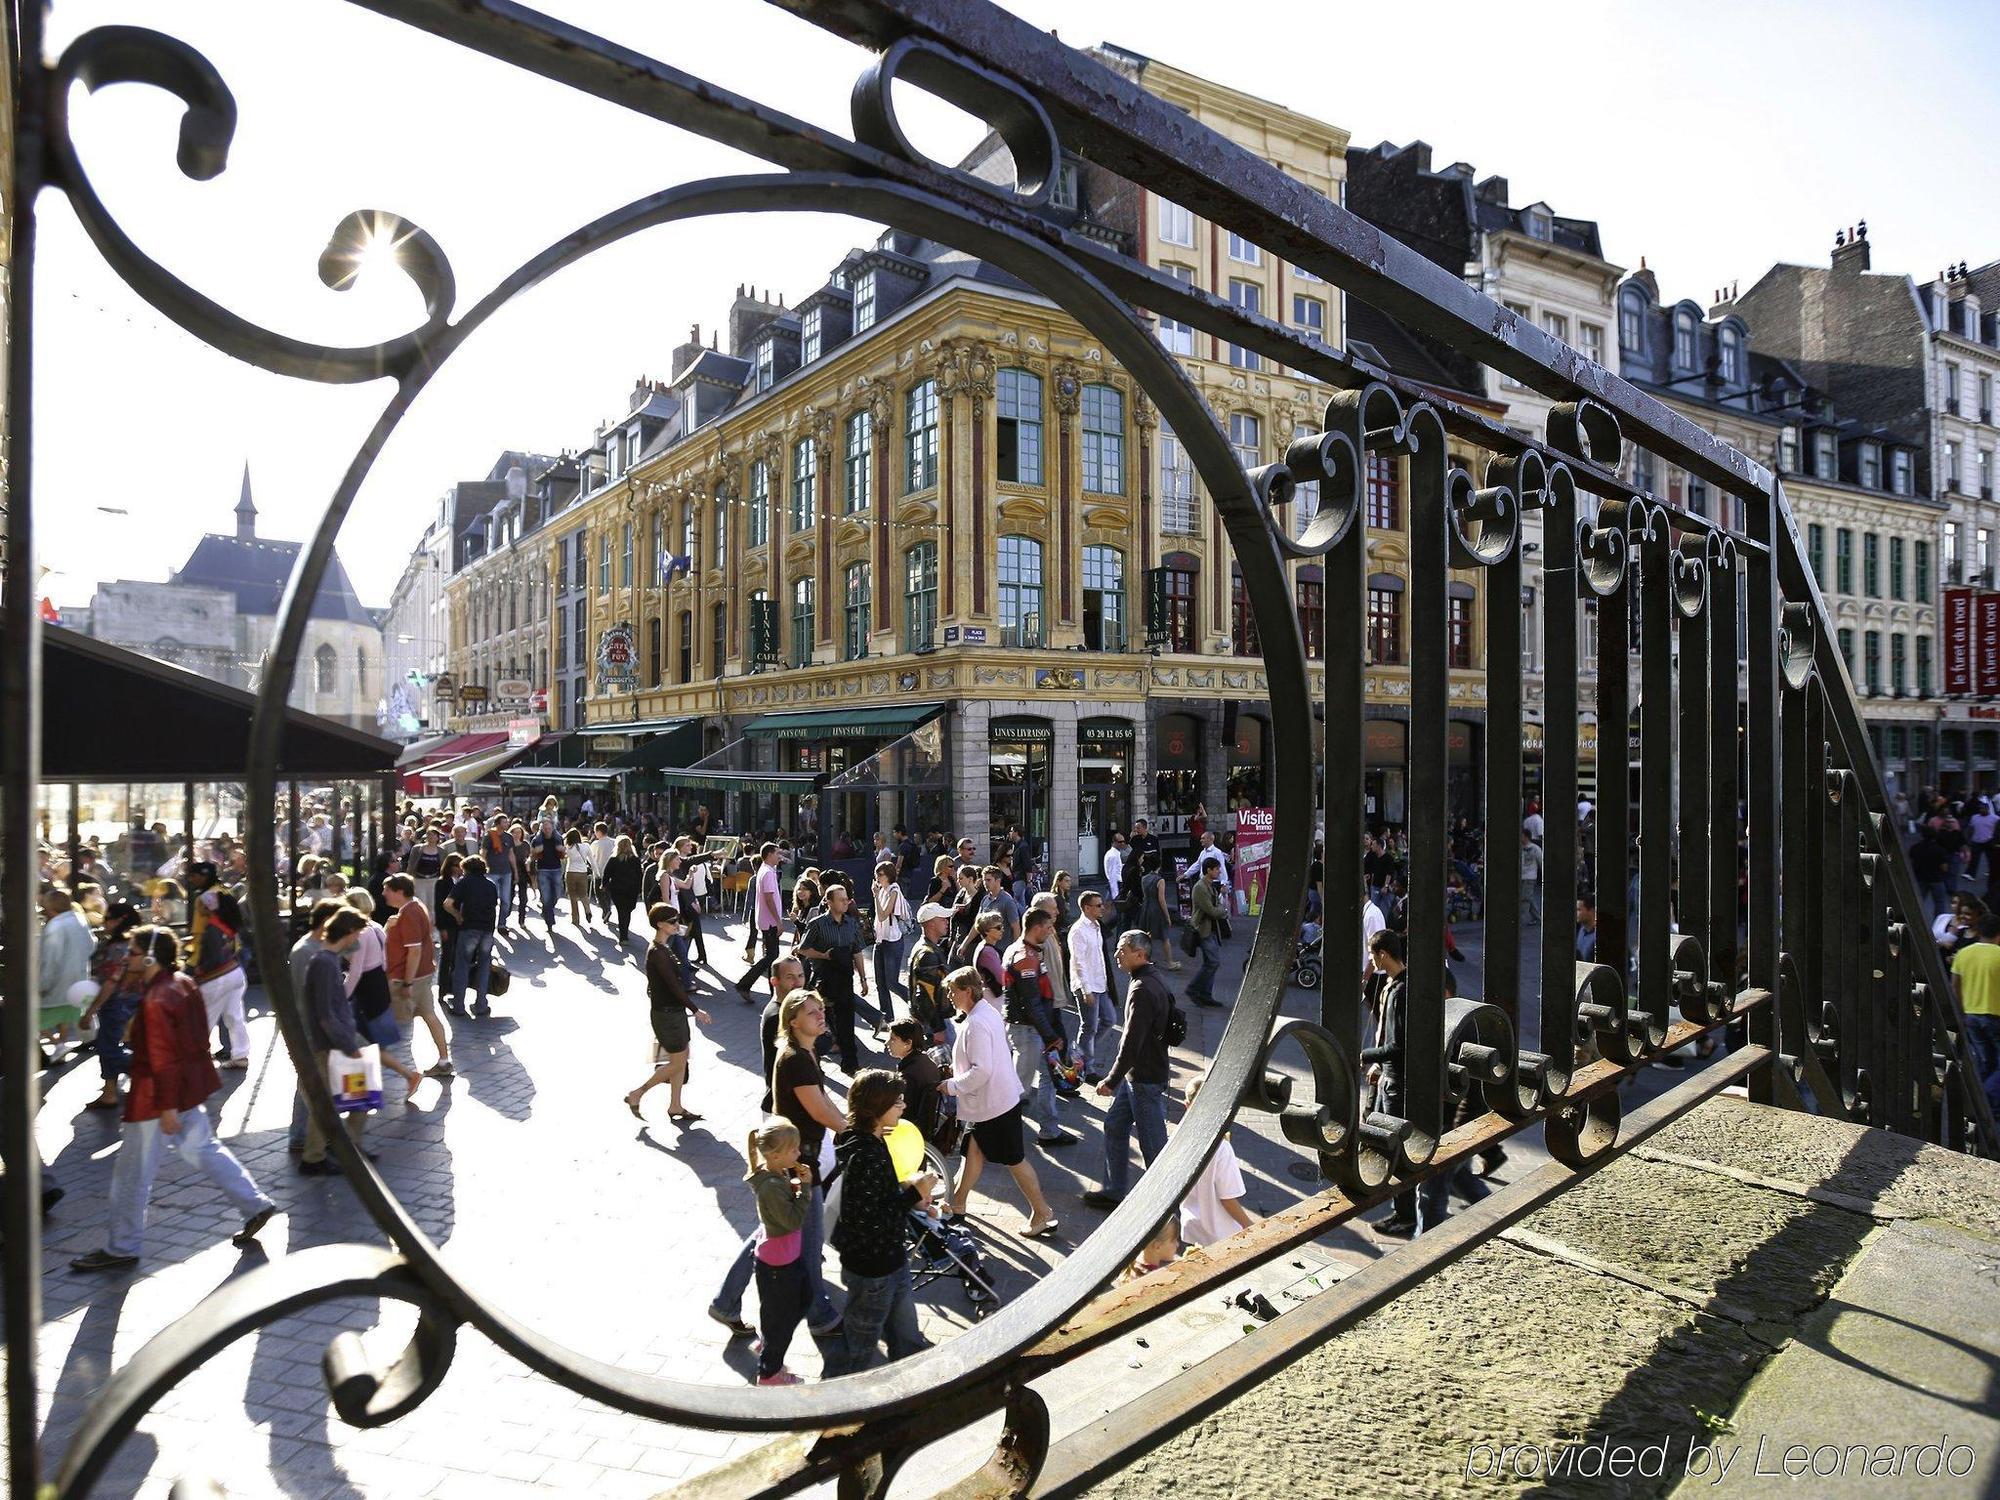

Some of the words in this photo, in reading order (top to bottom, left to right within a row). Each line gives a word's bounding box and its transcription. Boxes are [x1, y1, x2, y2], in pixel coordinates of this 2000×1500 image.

[1952, 598, 1966, 623] nord
[1983, 602, 1998, 628] nord
[1952, 628, 1966, 641] du
[1984, 631, 1997, 645] du
[1950, 645, 1966, 671] furet
[1982, 647, 1998, 673] furet
[1952, 674, 1966, 685] le
[1984, 676, 1998, 687] le
[994, 727, 1016, 737] LINA'S
[1016, 728, 1051, 737] LIVRAISON
[1086, 729, 1095, 738] 03
[1106, 729, 1114, 738] 12
[1238, 809, 1273, 825] Visite
